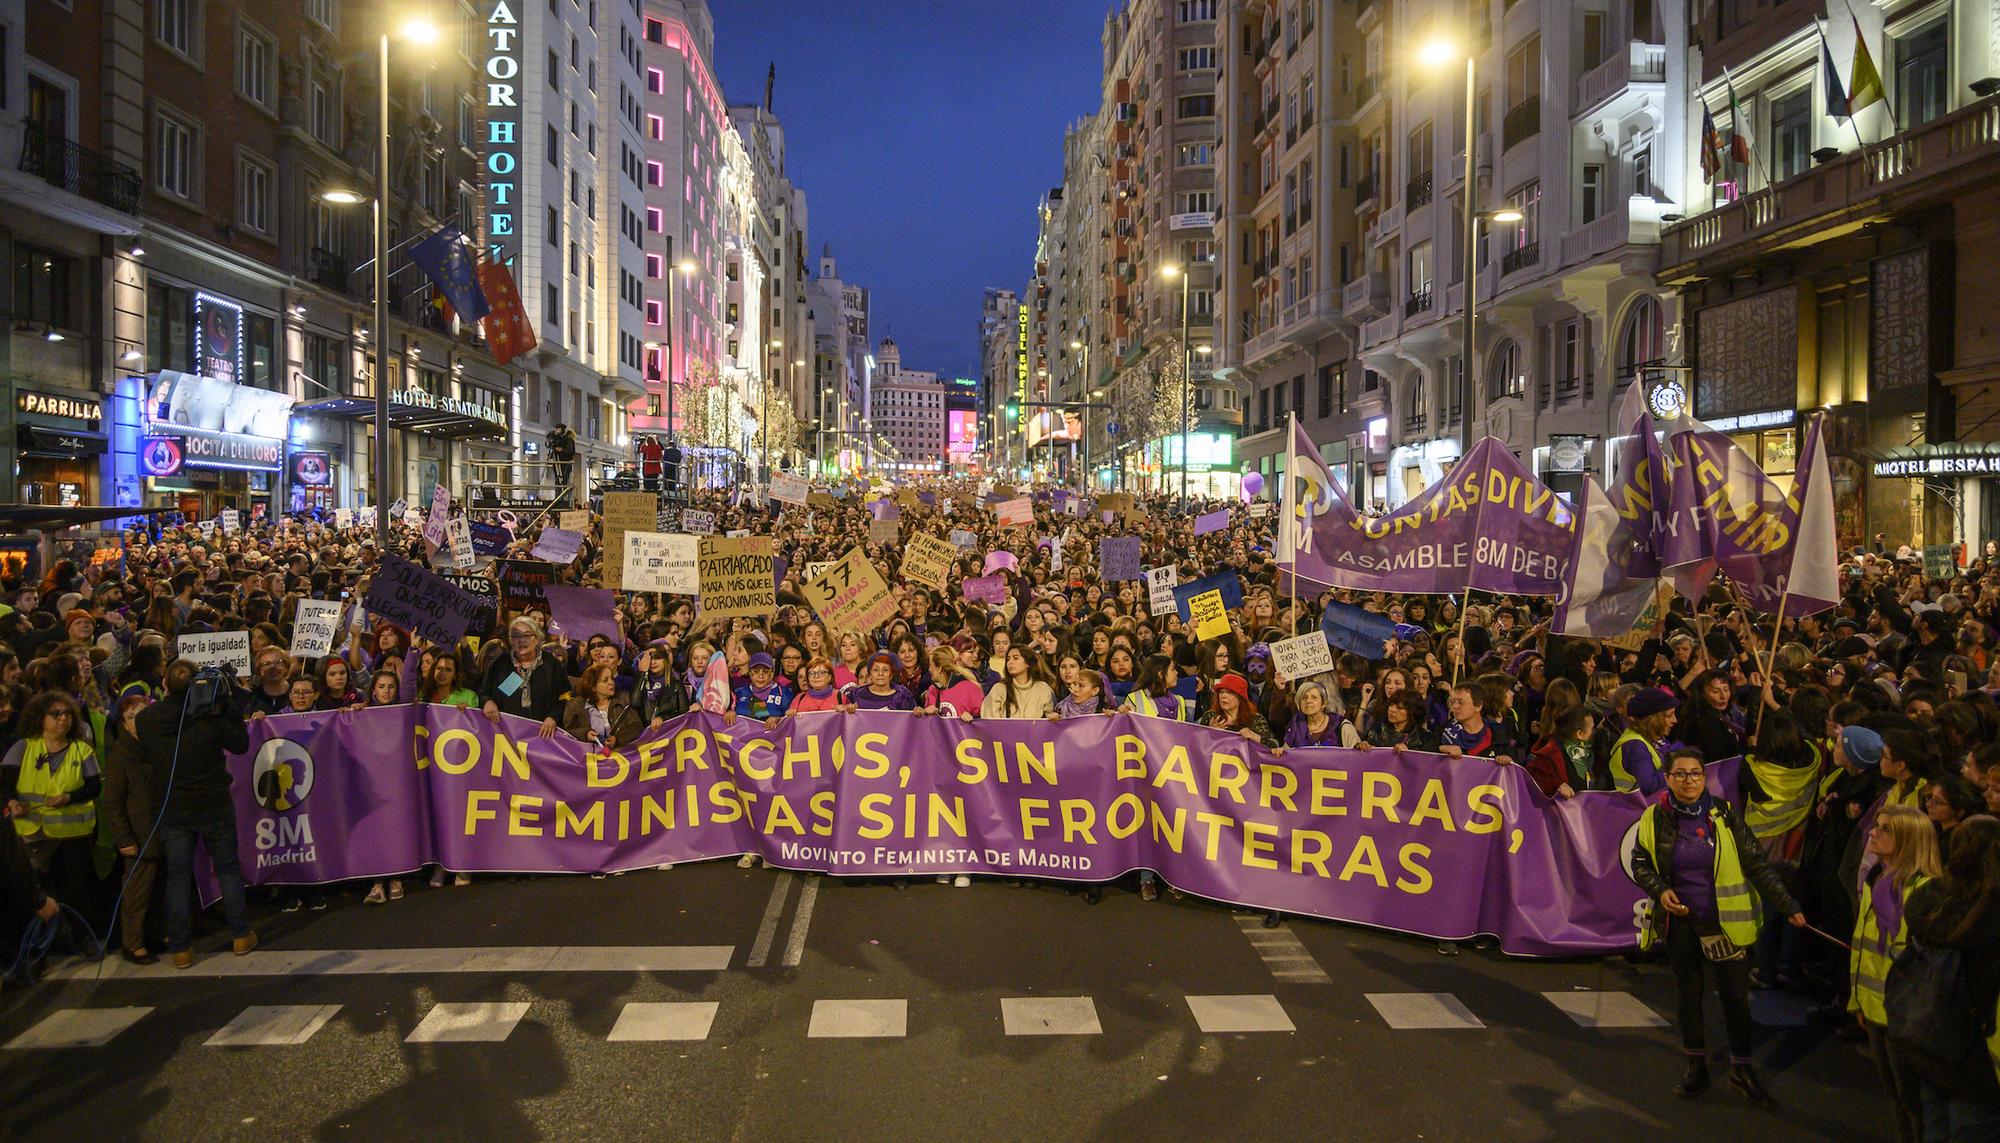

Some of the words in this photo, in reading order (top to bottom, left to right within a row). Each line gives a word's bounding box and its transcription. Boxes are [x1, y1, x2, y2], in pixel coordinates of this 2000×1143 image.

[1018, 305, 1028, 350] HOTEL
[206, 356, 234, 373] TEATRO
[26, 394, 102, 420] PARRILLA
[393, 389, 437, 410] HOTEL
[442, 396, 481, 418] SENATOR
[1018, 354, 1028, 432] EMPERDOR
[185, 436, 227, 459] HOCITA
[251, 445, 278, 463] LORO
[701, 541, 718, 556] EL
[1476, 536, 1508, 570] 8M
[1511, 545, 1540, 578] DE
[702, 582, 724, 593] MATA
[728, 577, 745, 592] MÁS
[747, 579, 762, 590] QUE
[765, 578, 773, 588] EL
[816, 561, 853, 601] 37
[704, 593, 774, 611] CORONAVIRUS
[821, 576, 870, 619] MANADAS
[198, 640, 206, 652] la
[208, 637, 247, 654] igualdad:
[414, 725, 531, 781] CON
[955, 738, 1058, 785] SIN
[1115, 734, 1524, 854] BARRERAS,
[255, 813, 314, 850] 8M
[464, 780, 836, 841] FEMINISTAS
[857, 792, 967, 840] SIN
[1019, 792, 1434, 895] FRONTERAS
[256, 846, 316, 869] Madrid
